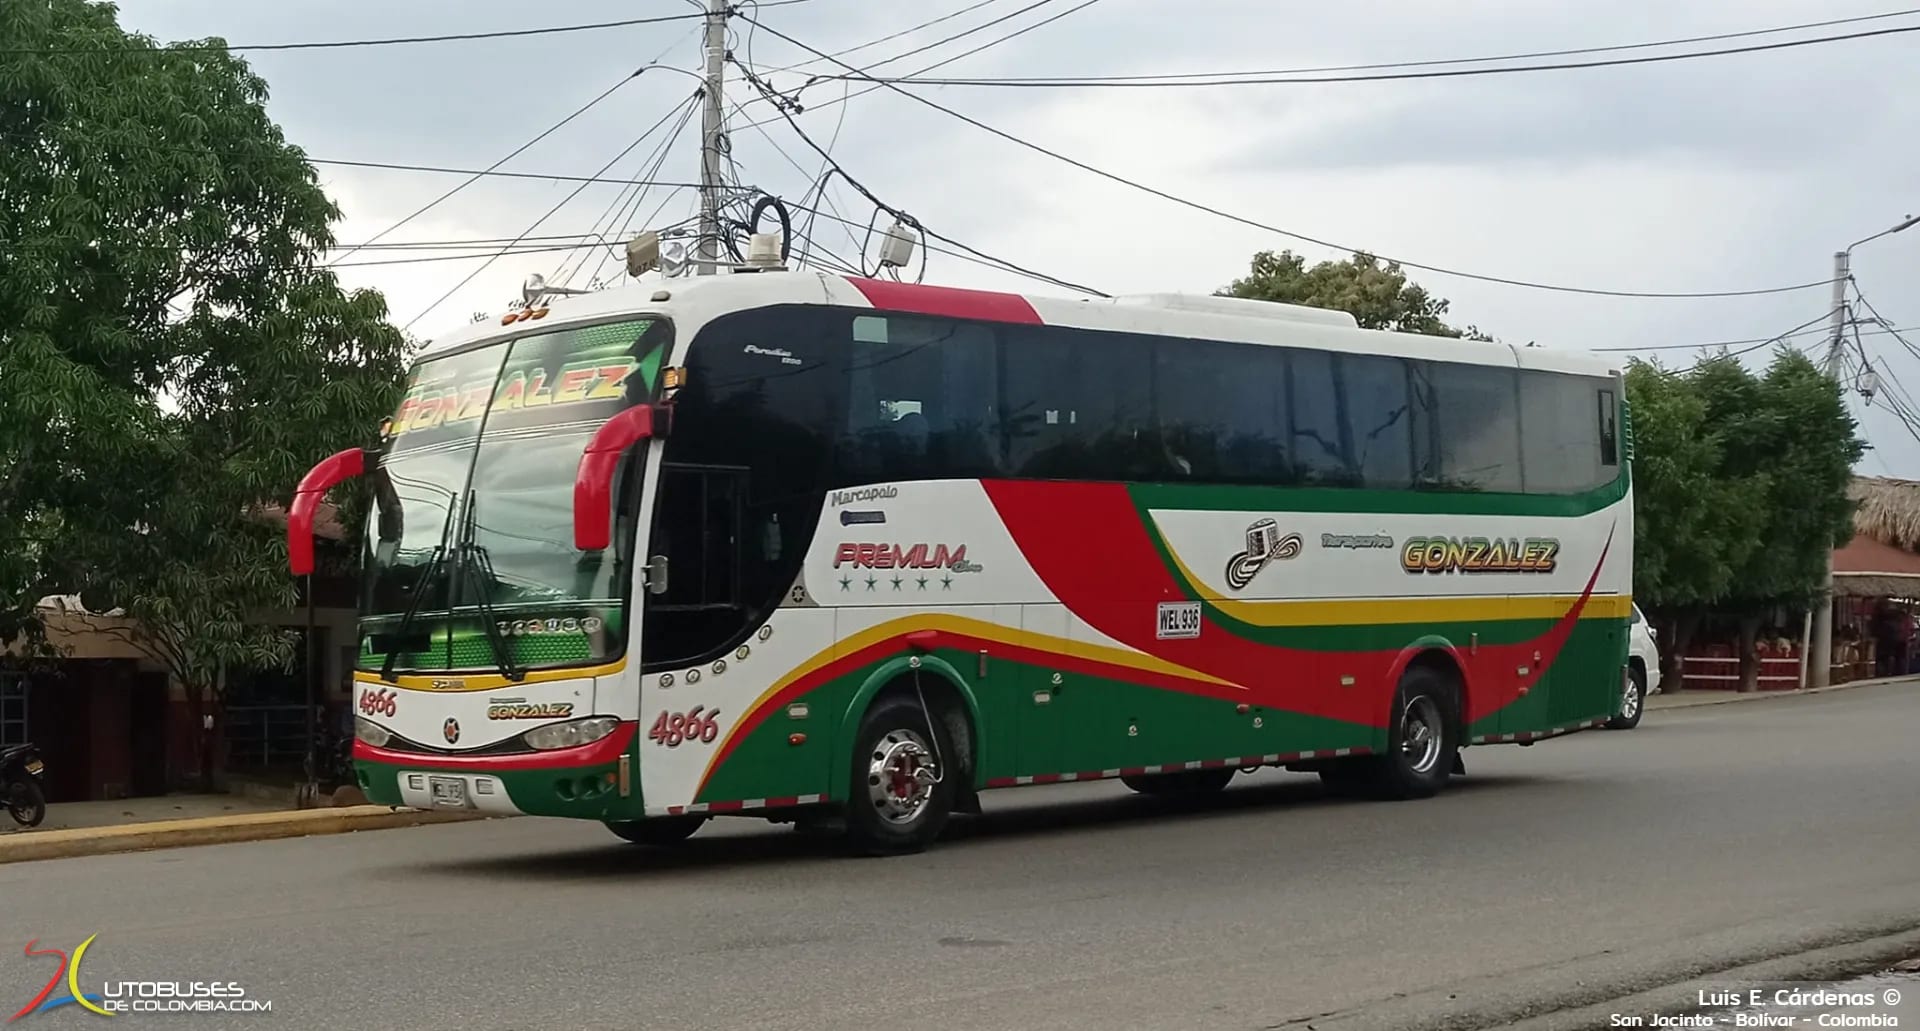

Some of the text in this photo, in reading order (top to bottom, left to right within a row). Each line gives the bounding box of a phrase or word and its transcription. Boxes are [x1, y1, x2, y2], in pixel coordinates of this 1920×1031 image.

[831, 485, 898, 507] Marcopolo
[833, 543, 967, 569] PREMIUM
[1401, 537, 1559, 574] GONZALEZ
[1160, 608, 1199, 630] WEL 936
[360, 687, 397, 718] 4866
[488, 702, 574, 720] GONZALEZ
[648, 704, 720, 747] 4866
